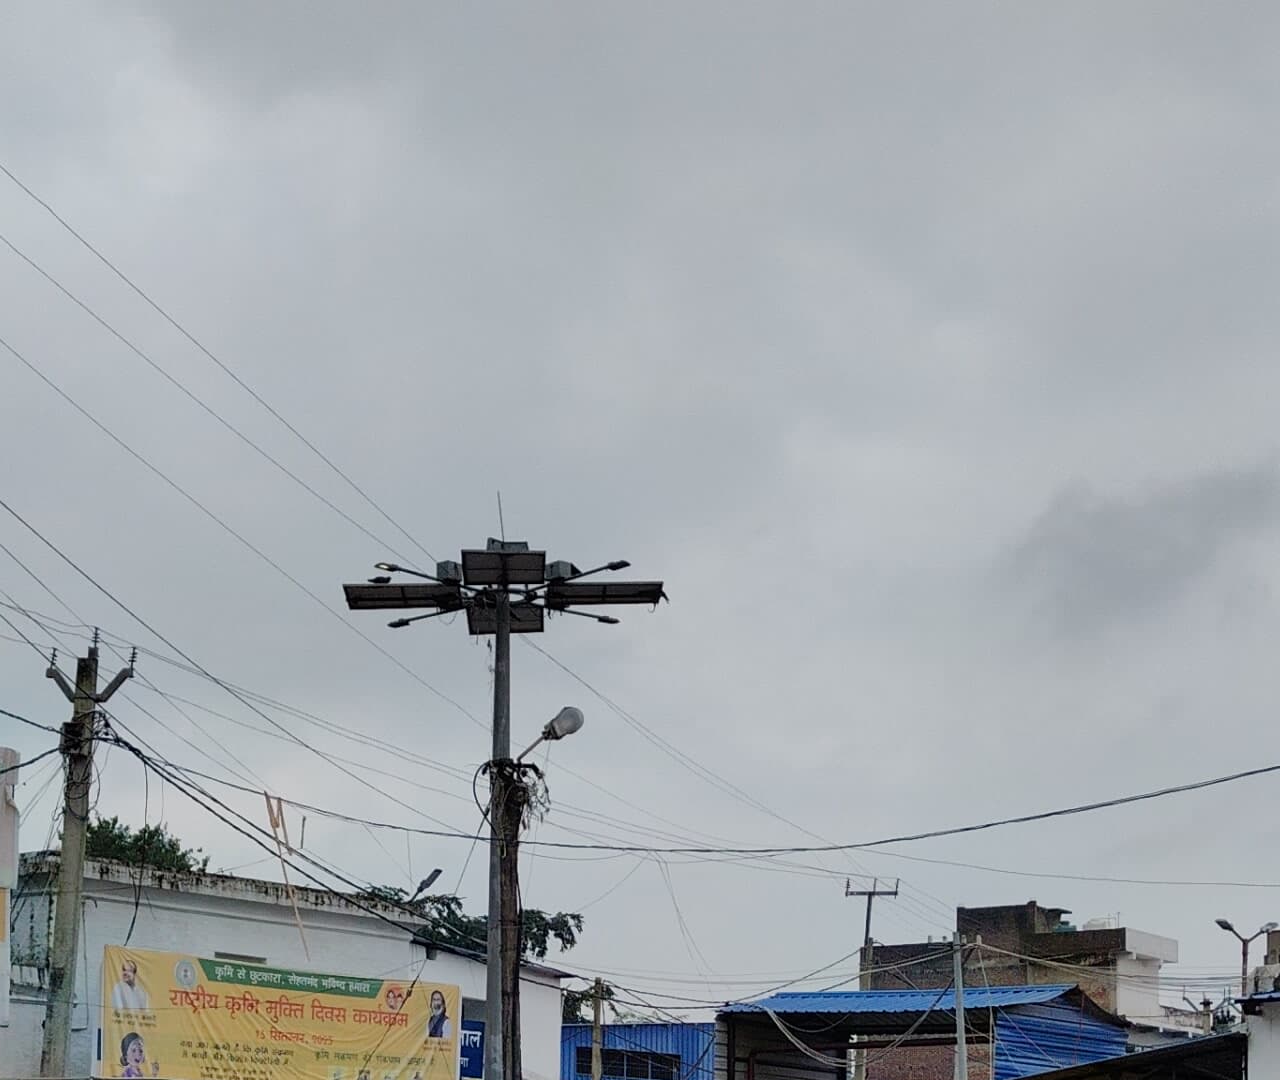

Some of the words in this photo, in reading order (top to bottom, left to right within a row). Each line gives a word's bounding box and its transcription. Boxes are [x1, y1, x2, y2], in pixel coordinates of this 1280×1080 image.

[213, 965, 234, 981] कृमि
[236, 967, 247, 980] से
[169, 984, 219, 1014] राष्ट्रीय
[225, 991, 260, 1019] कृमि
[265, 995, 305, 1023] मुक्ति
[310, 999, 347, 1024] दिवस
